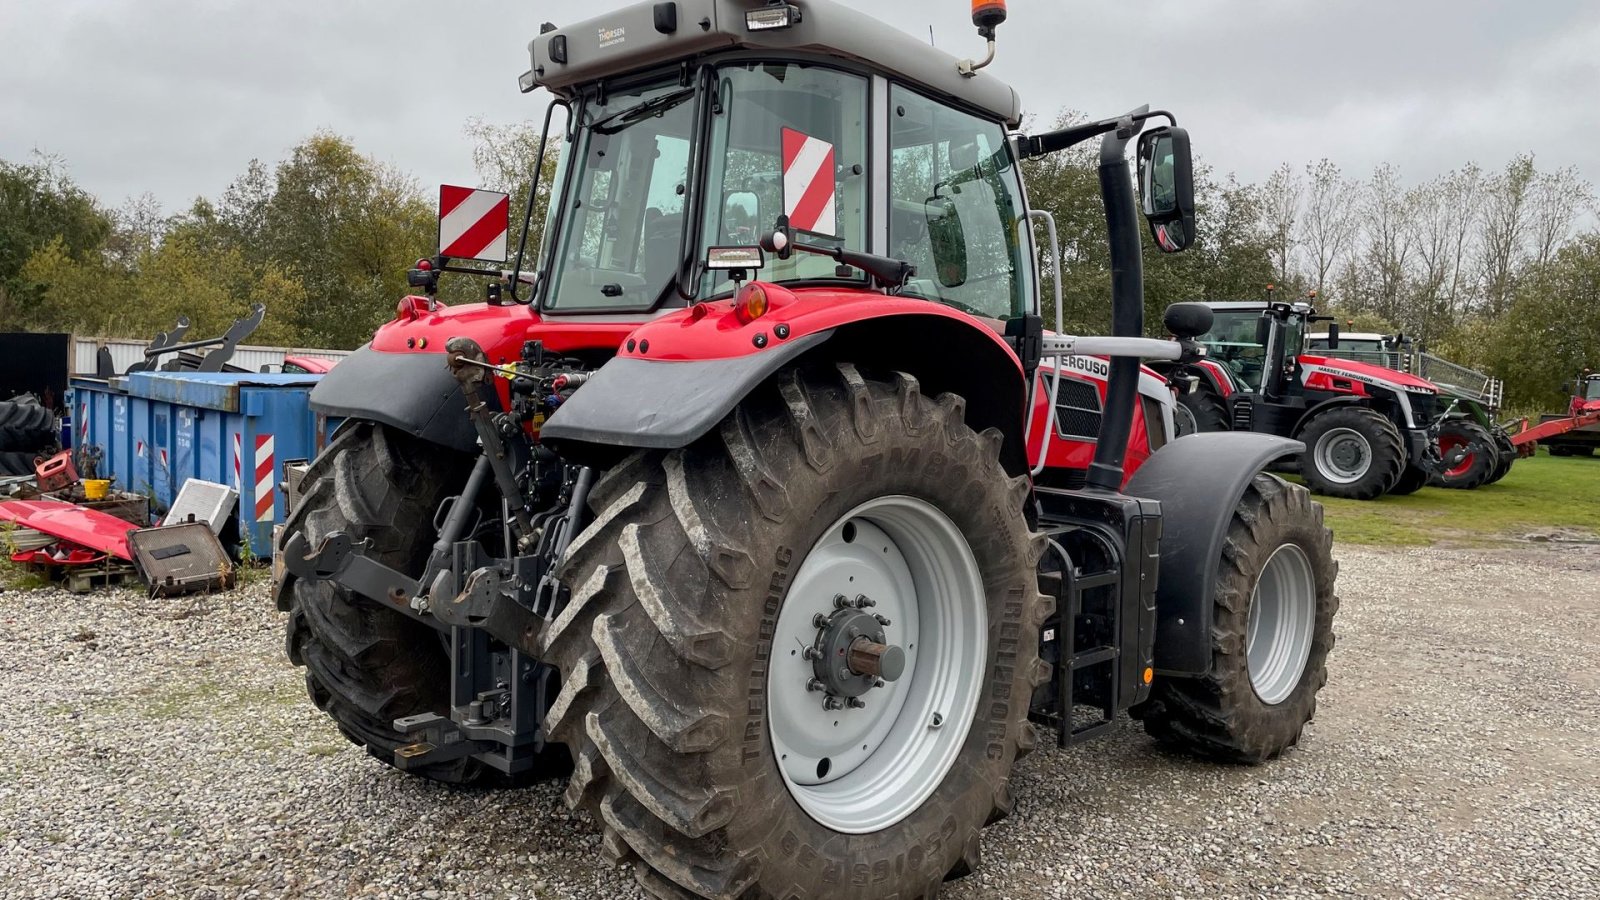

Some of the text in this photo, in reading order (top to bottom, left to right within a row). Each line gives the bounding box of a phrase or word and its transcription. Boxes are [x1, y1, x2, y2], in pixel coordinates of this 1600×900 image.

[599, 27, 625, 42] THORSEN
[1060, 354, 1108, 376] ERGUSO
[1318, 366, 1374, 383] MASSEY FERGUSON
[740, 545, 793, 767] TRELLEBORG
[986, 583, 1026, 761] TRELLEBORG
